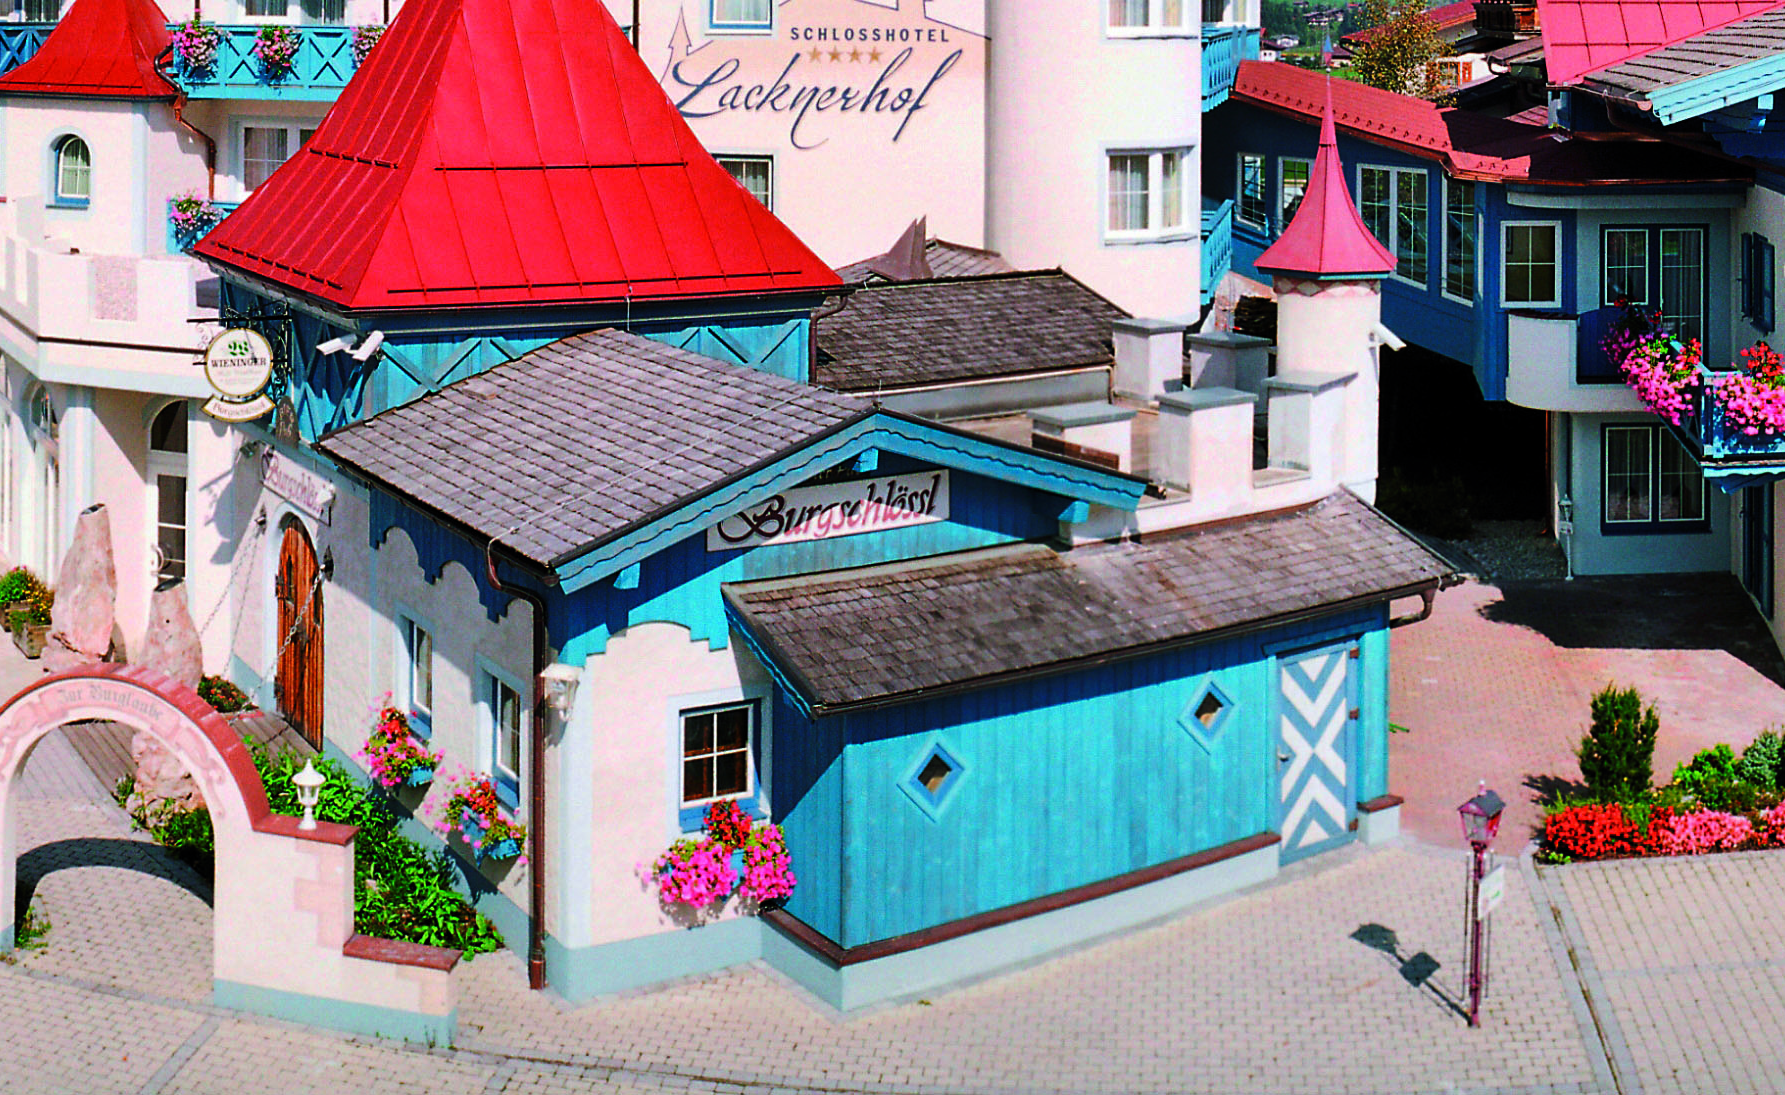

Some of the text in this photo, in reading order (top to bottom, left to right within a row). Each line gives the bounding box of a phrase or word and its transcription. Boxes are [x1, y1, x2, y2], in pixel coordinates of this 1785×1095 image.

[790, 26, 950, 43] SCHLOSSHOTEL
[672, 46, 964, 150] Lacknerhof
[211, 357, 267, 369] WIENINGER
[717, 473, 942, 543] Burgschlössl
